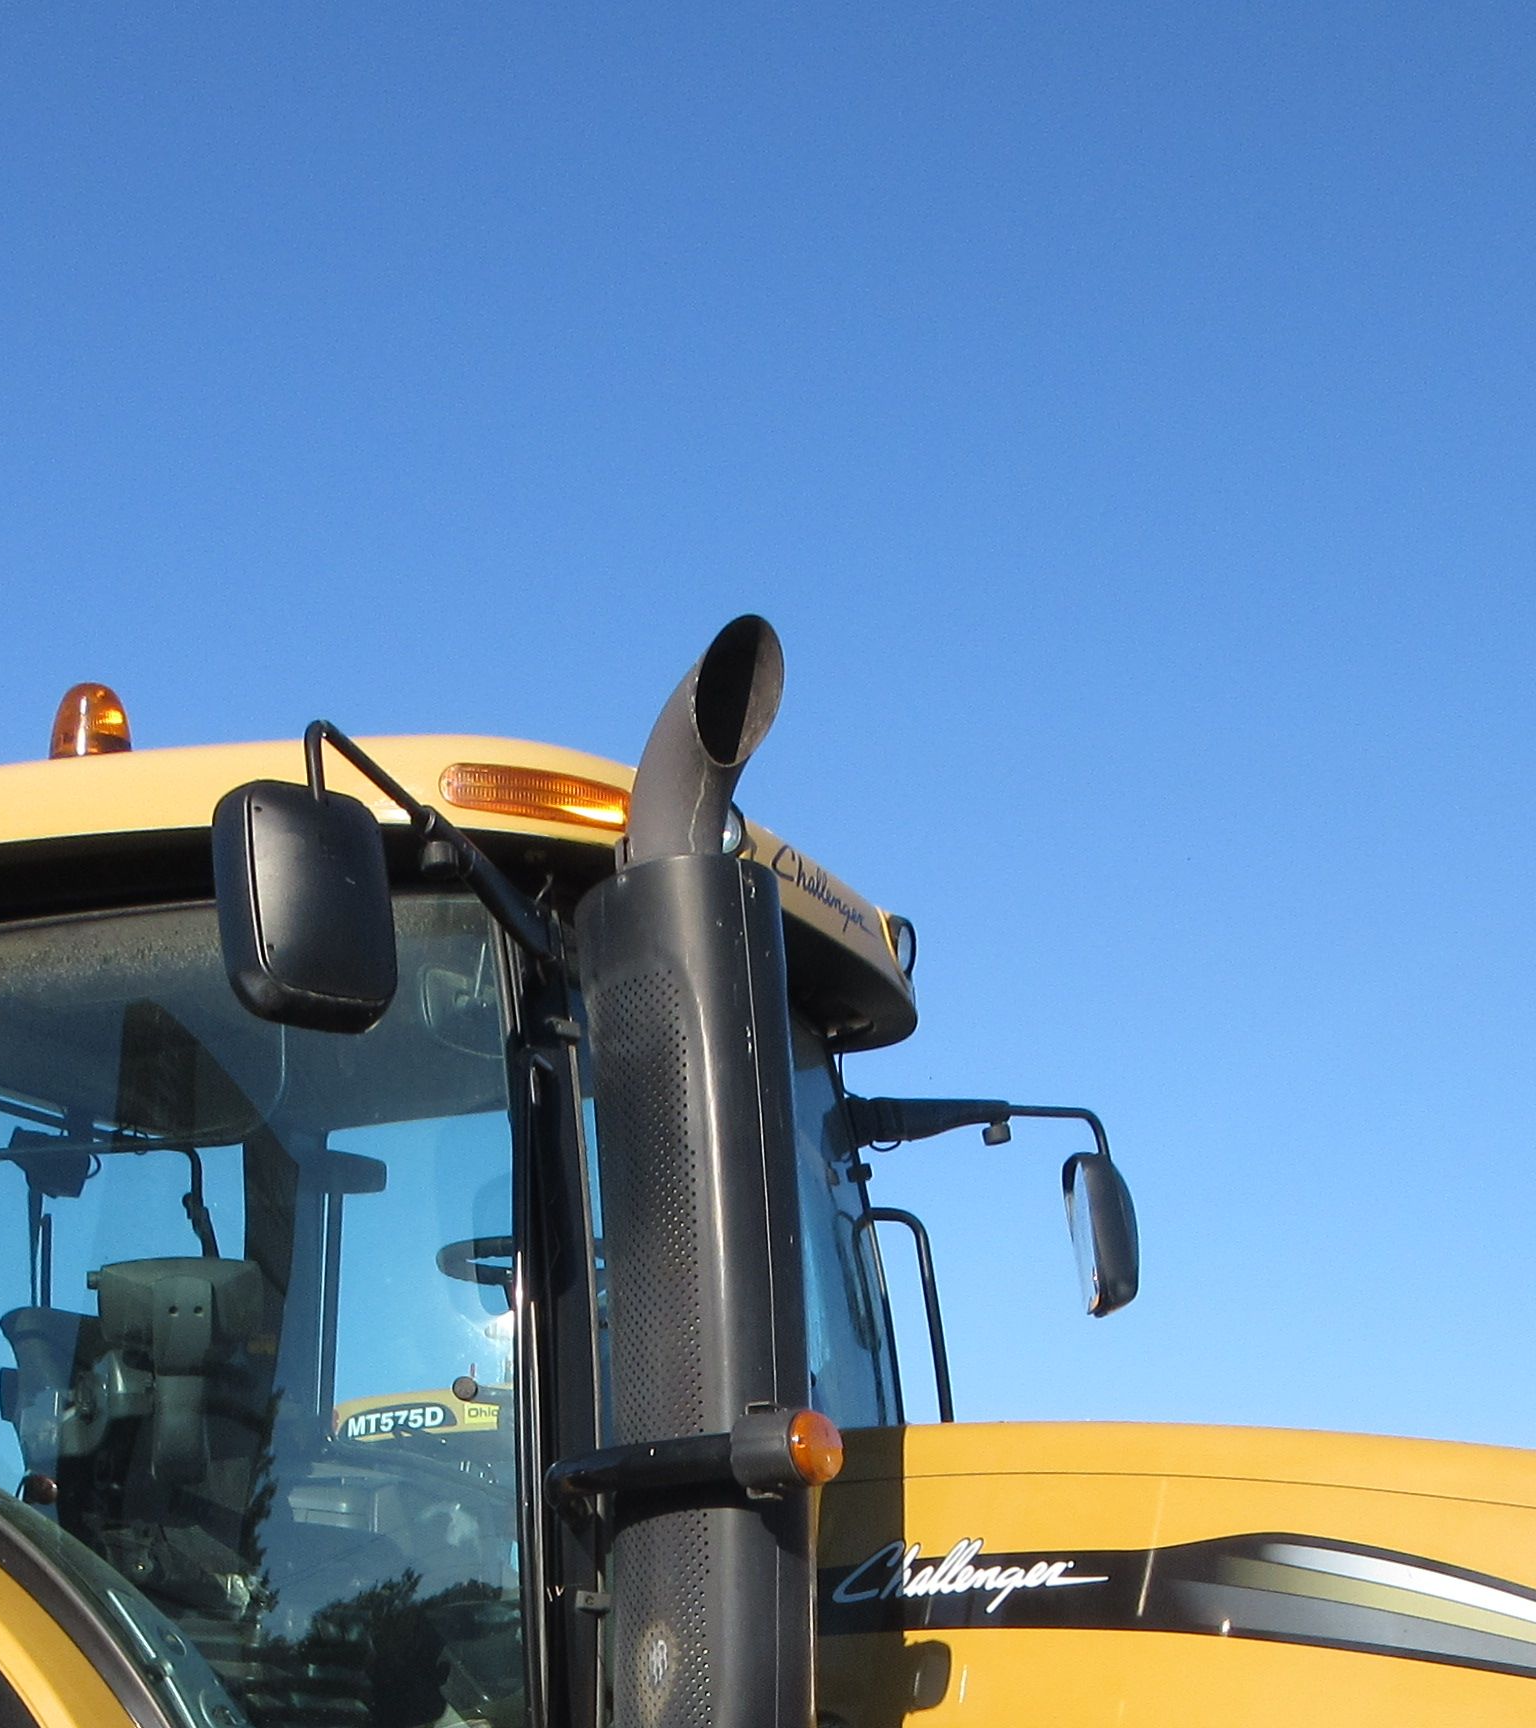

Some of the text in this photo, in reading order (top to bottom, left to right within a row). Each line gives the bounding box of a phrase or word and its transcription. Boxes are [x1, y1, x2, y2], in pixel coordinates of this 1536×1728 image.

[770, 844, 876, 939] Challenger
[347, 1406, 444, 1438] MT575D
[832, 1537, 1110, 1614] Challenger
